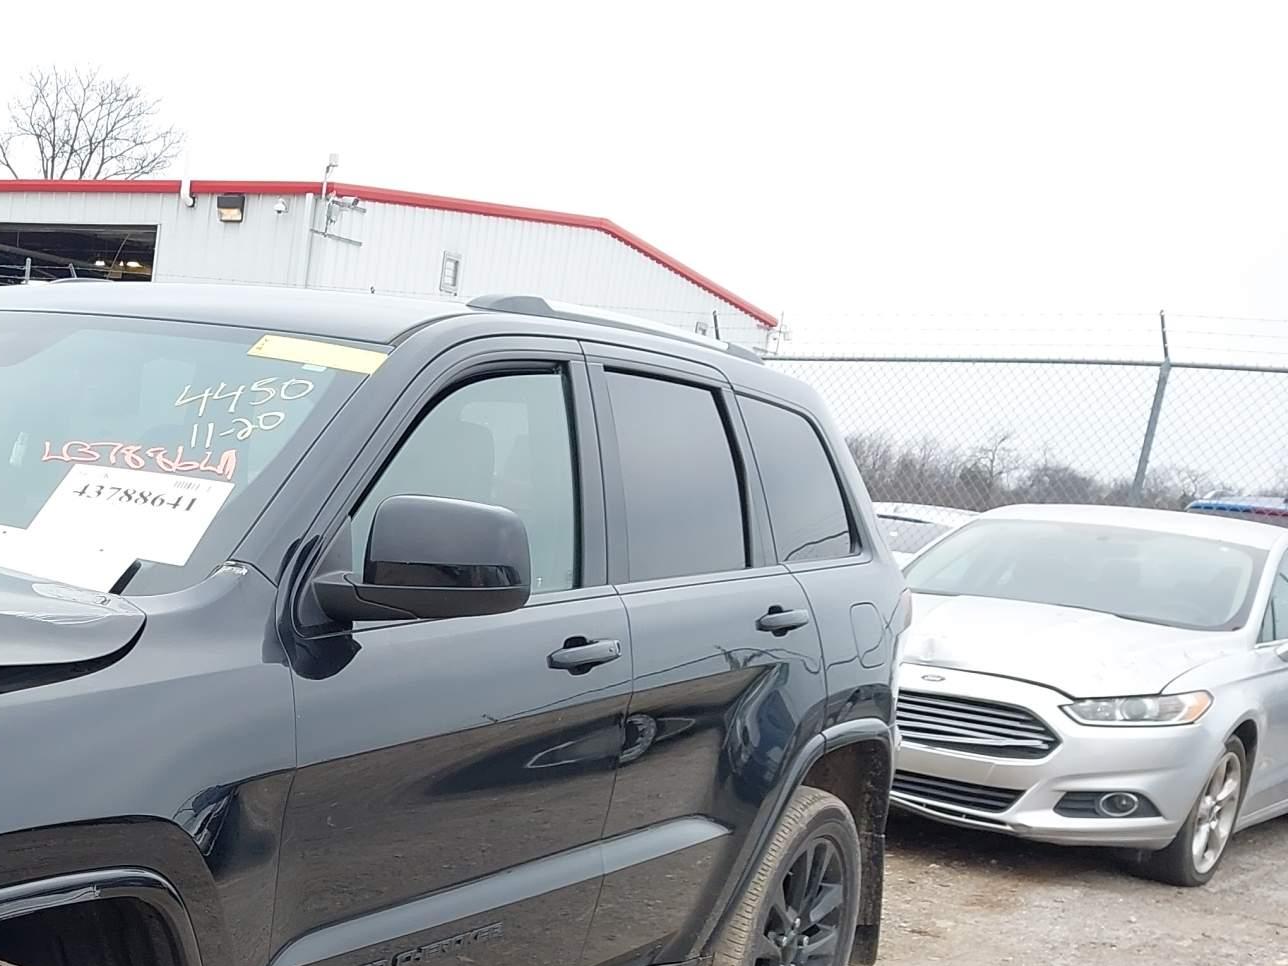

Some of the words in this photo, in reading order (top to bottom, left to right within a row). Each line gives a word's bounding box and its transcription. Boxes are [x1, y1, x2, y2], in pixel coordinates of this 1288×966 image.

[174, 376, 314, 417] 4450
[190, 411, 286, 449] 11-20
[73, 483, 198, 512] 43788641
